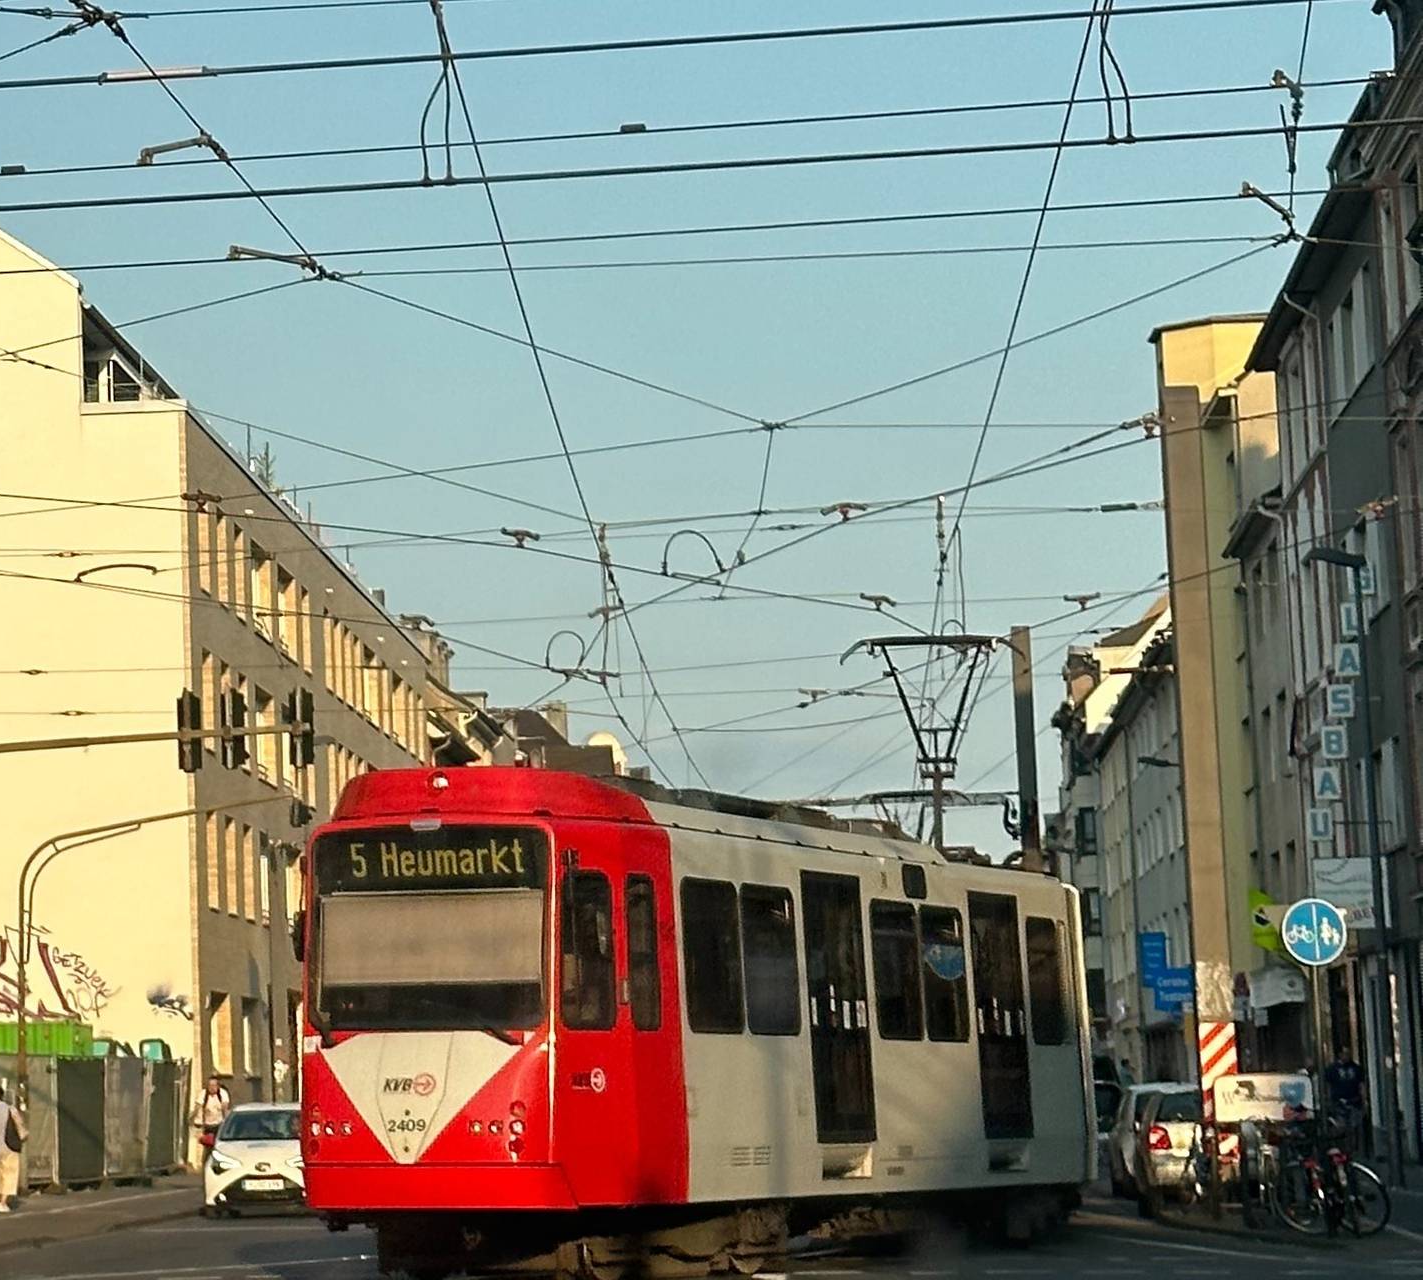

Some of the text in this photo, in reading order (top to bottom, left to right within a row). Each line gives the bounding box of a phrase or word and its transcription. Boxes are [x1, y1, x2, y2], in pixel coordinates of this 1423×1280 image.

[350, 838, 525, 878] 5 Heumarkt
[383, 1078, 413, 1092] KVB
[388, 1119, 426, 1132] 2409
